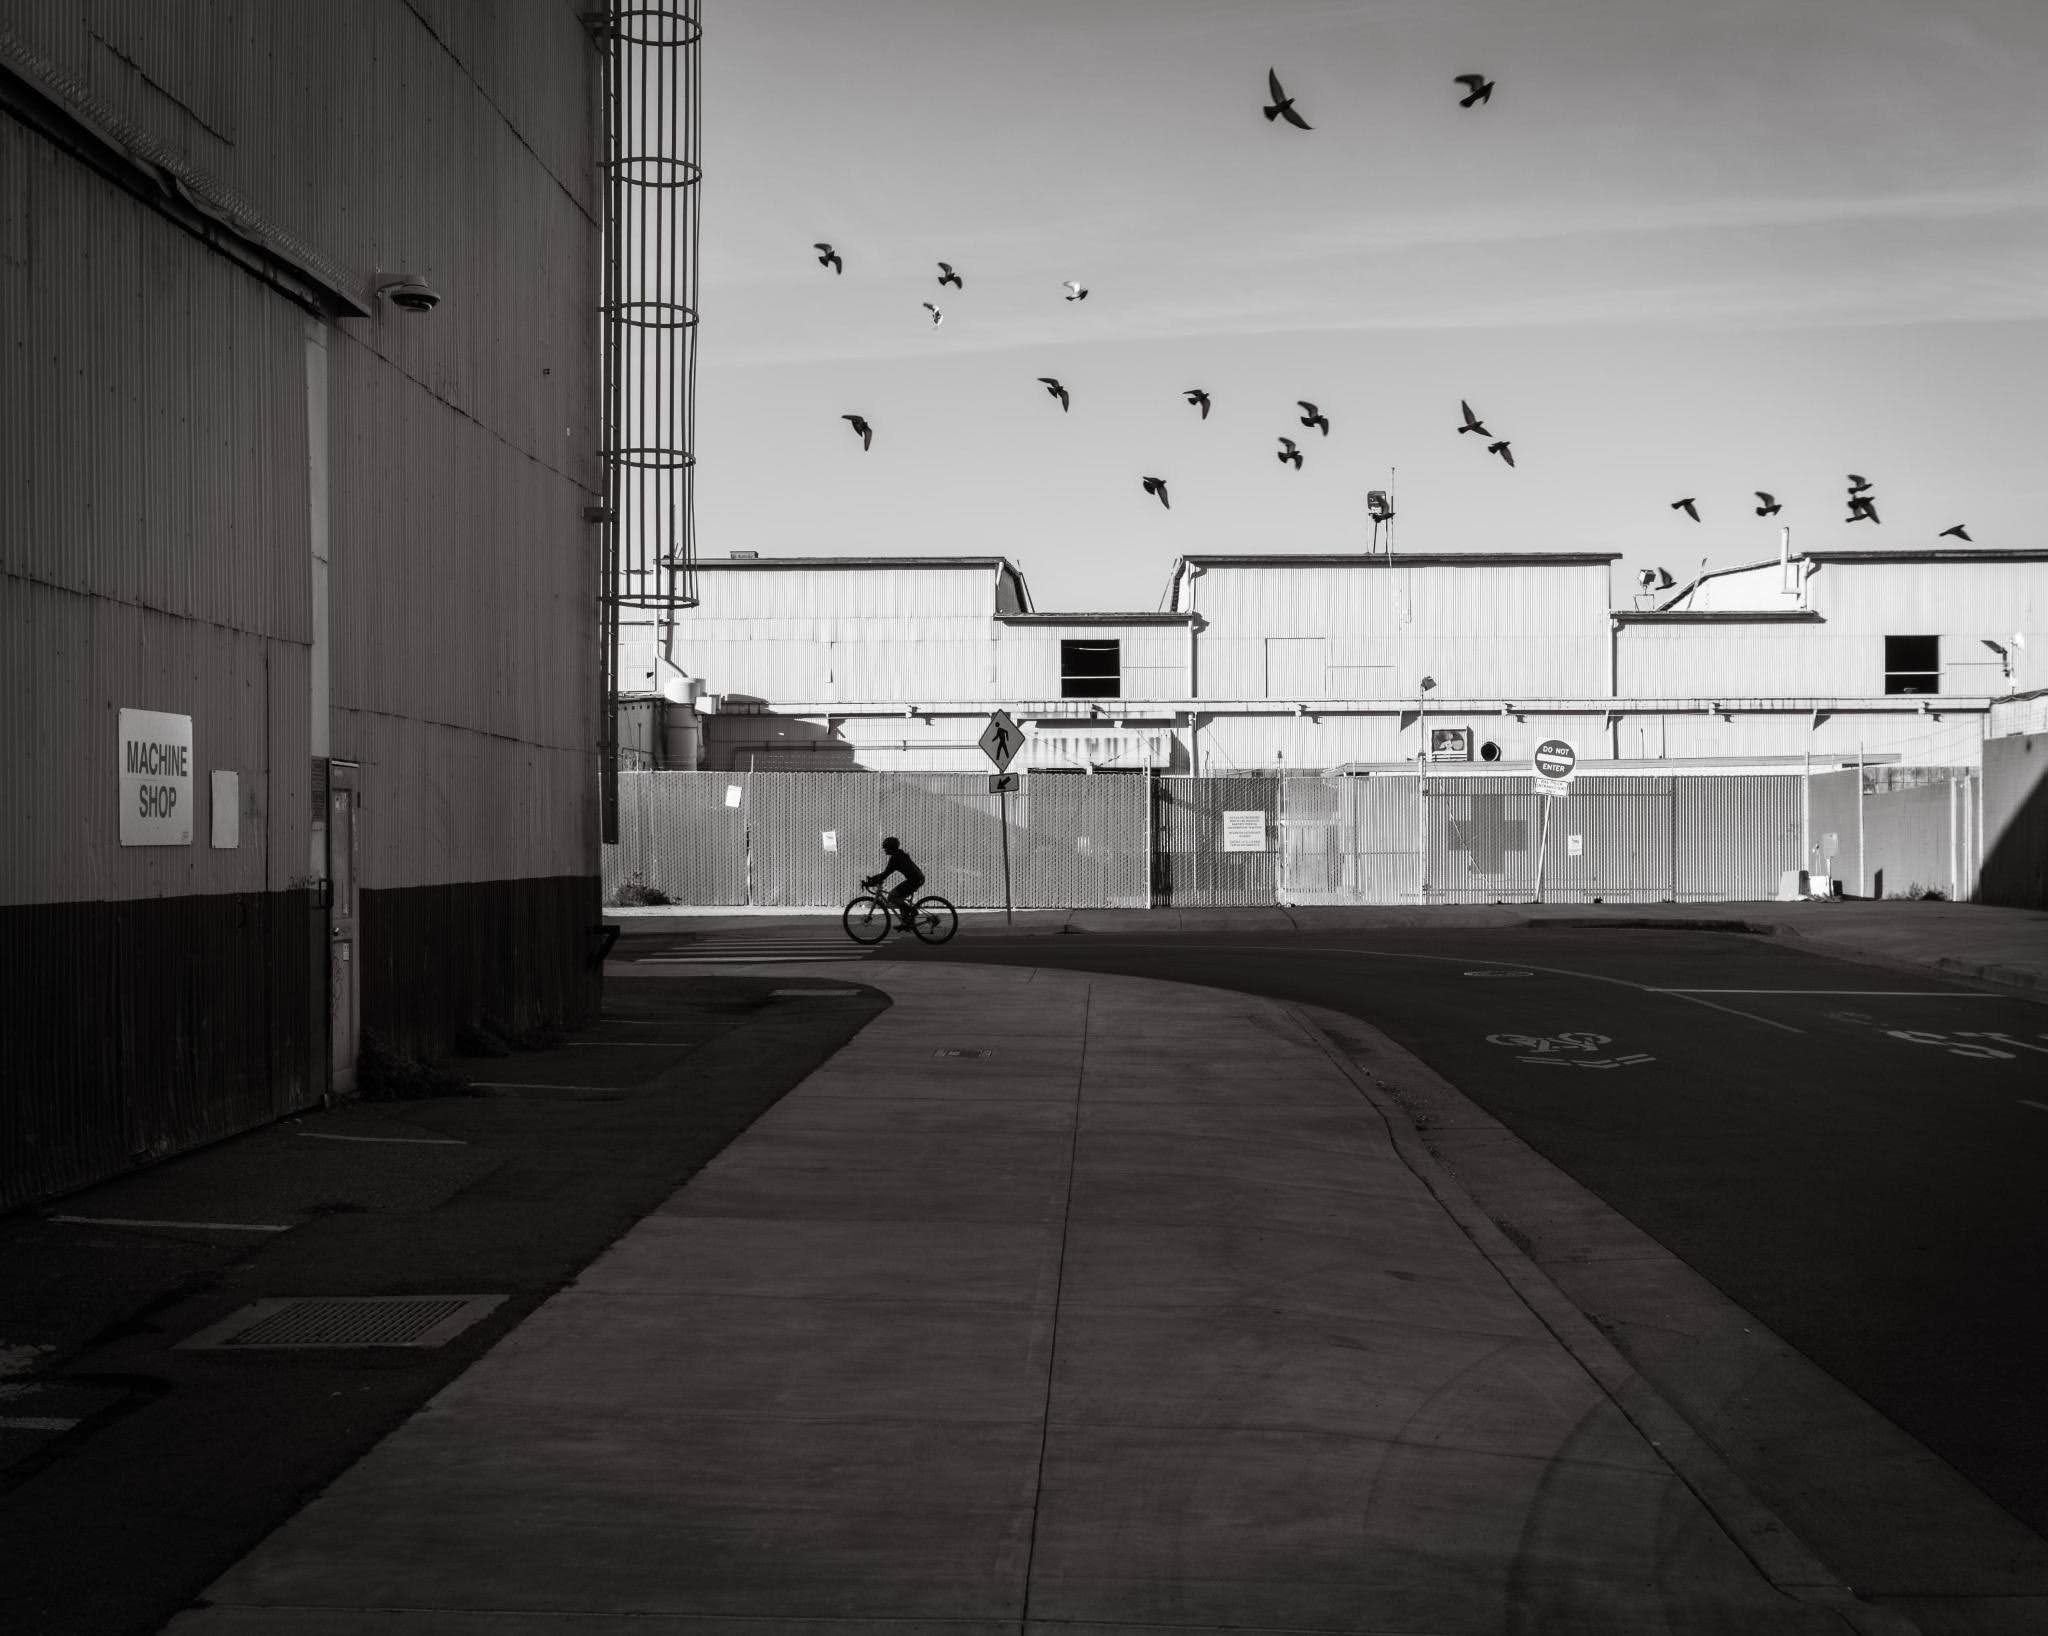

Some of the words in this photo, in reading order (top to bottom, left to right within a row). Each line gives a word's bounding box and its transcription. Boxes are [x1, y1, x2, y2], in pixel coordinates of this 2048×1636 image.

[127, 740, 188, 777] MACHINE
[1542, 745, 1553, 754] DO
[1555, 747, 1570, 756] NOT
[1542, 763, 1566, 773] ENTER
[139, 784, 177, 818] SHOP
